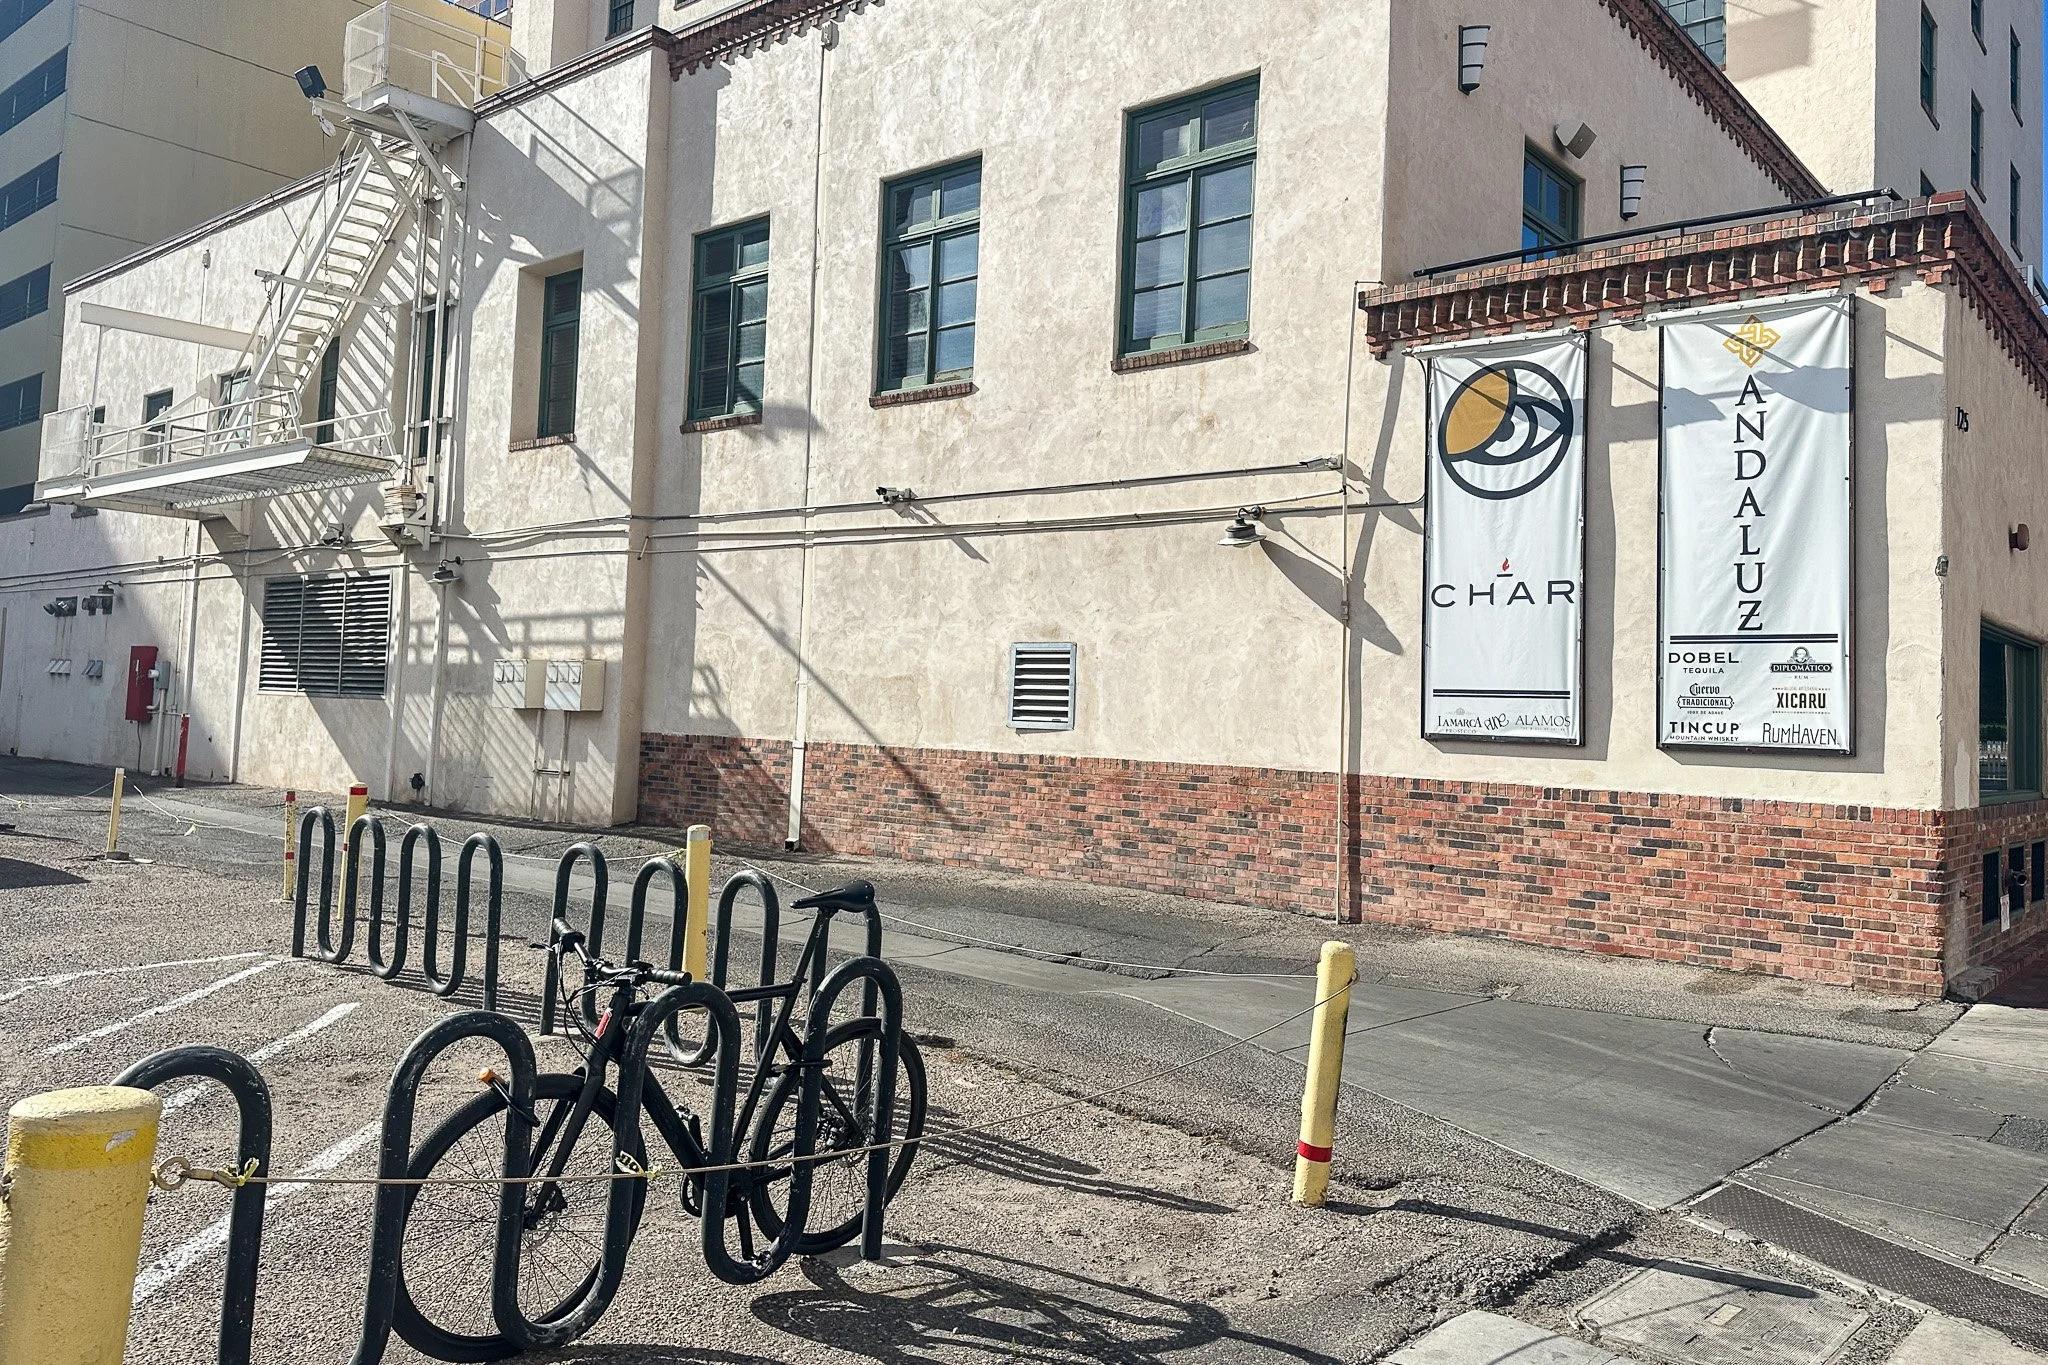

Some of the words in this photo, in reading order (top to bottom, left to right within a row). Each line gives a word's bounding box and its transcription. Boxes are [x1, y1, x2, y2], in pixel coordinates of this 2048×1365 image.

[1955, 406, 1969, 432] 125
[1734, 374, 1767, 631] ANDALUZ
[1431, 580, 1575, 608] CHAR
[1669, 652, 1739, 664] DOBEL
[1689, 682, 1720, 697] Cuervo
[1682, 698, 1728, 707] TRADICIONAL
[1777, 692, 1826, 709] XICARU
[1515, 715, 1571, 727] ALAMOS
[1669, 721, 1739, 735] TINCUP
